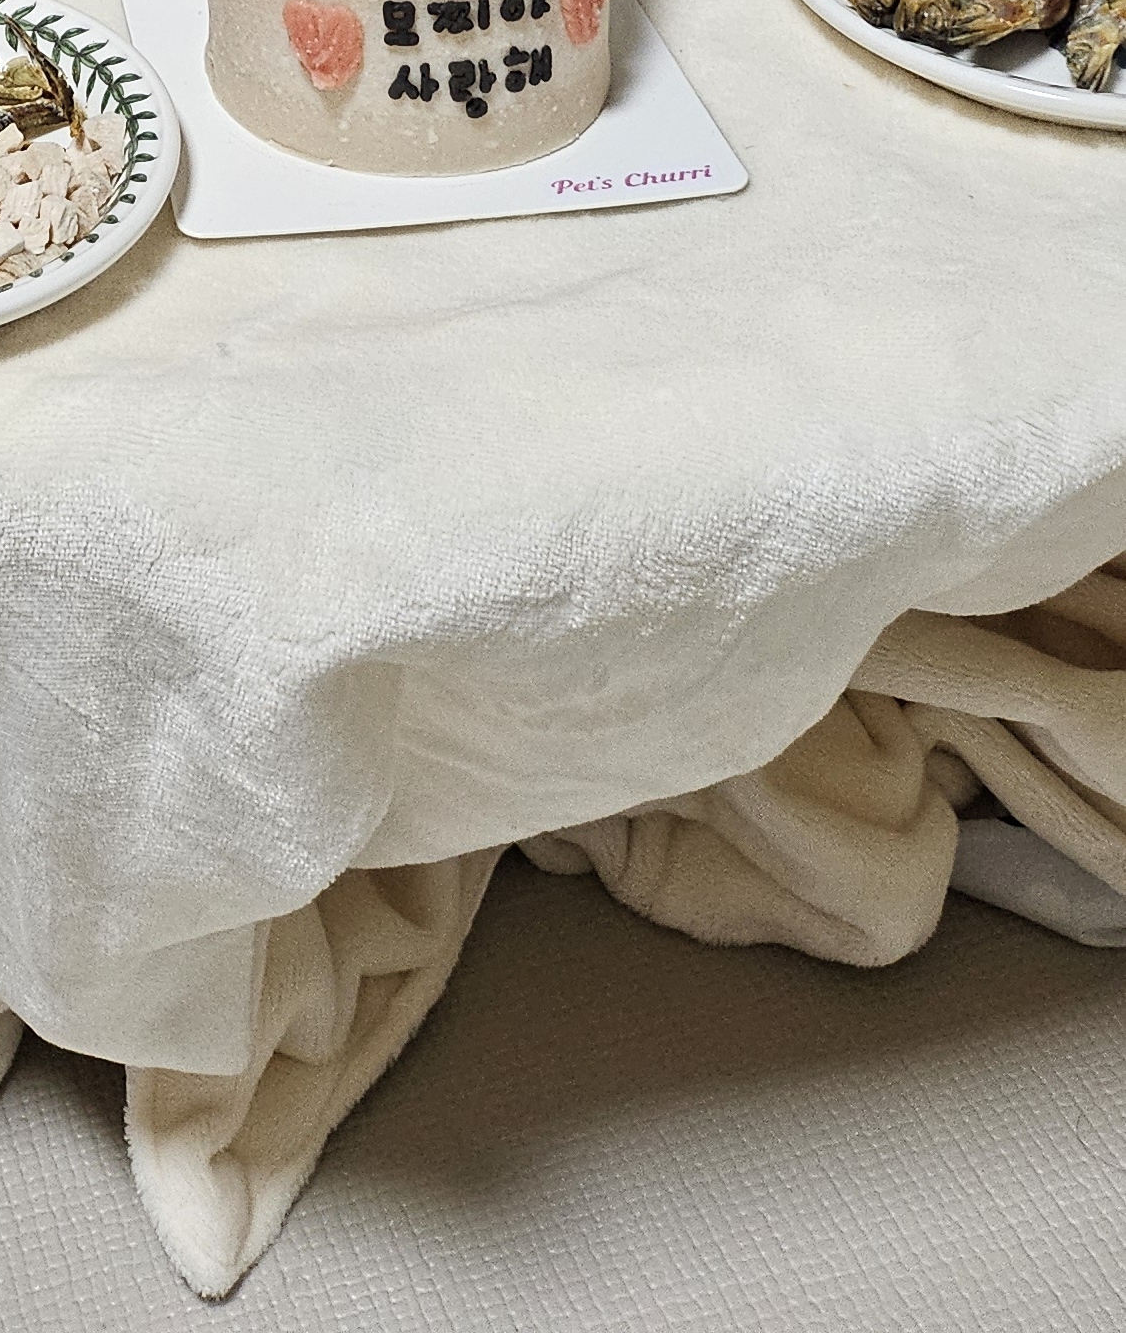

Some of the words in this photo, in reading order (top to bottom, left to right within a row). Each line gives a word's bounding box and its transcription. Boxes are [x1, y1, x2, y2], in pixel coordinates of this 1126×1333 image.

[388, 44, 552, 118] 사랑해
[550, 175, 613, 195] Pet's
[624, 164, 713, 187] Churri
